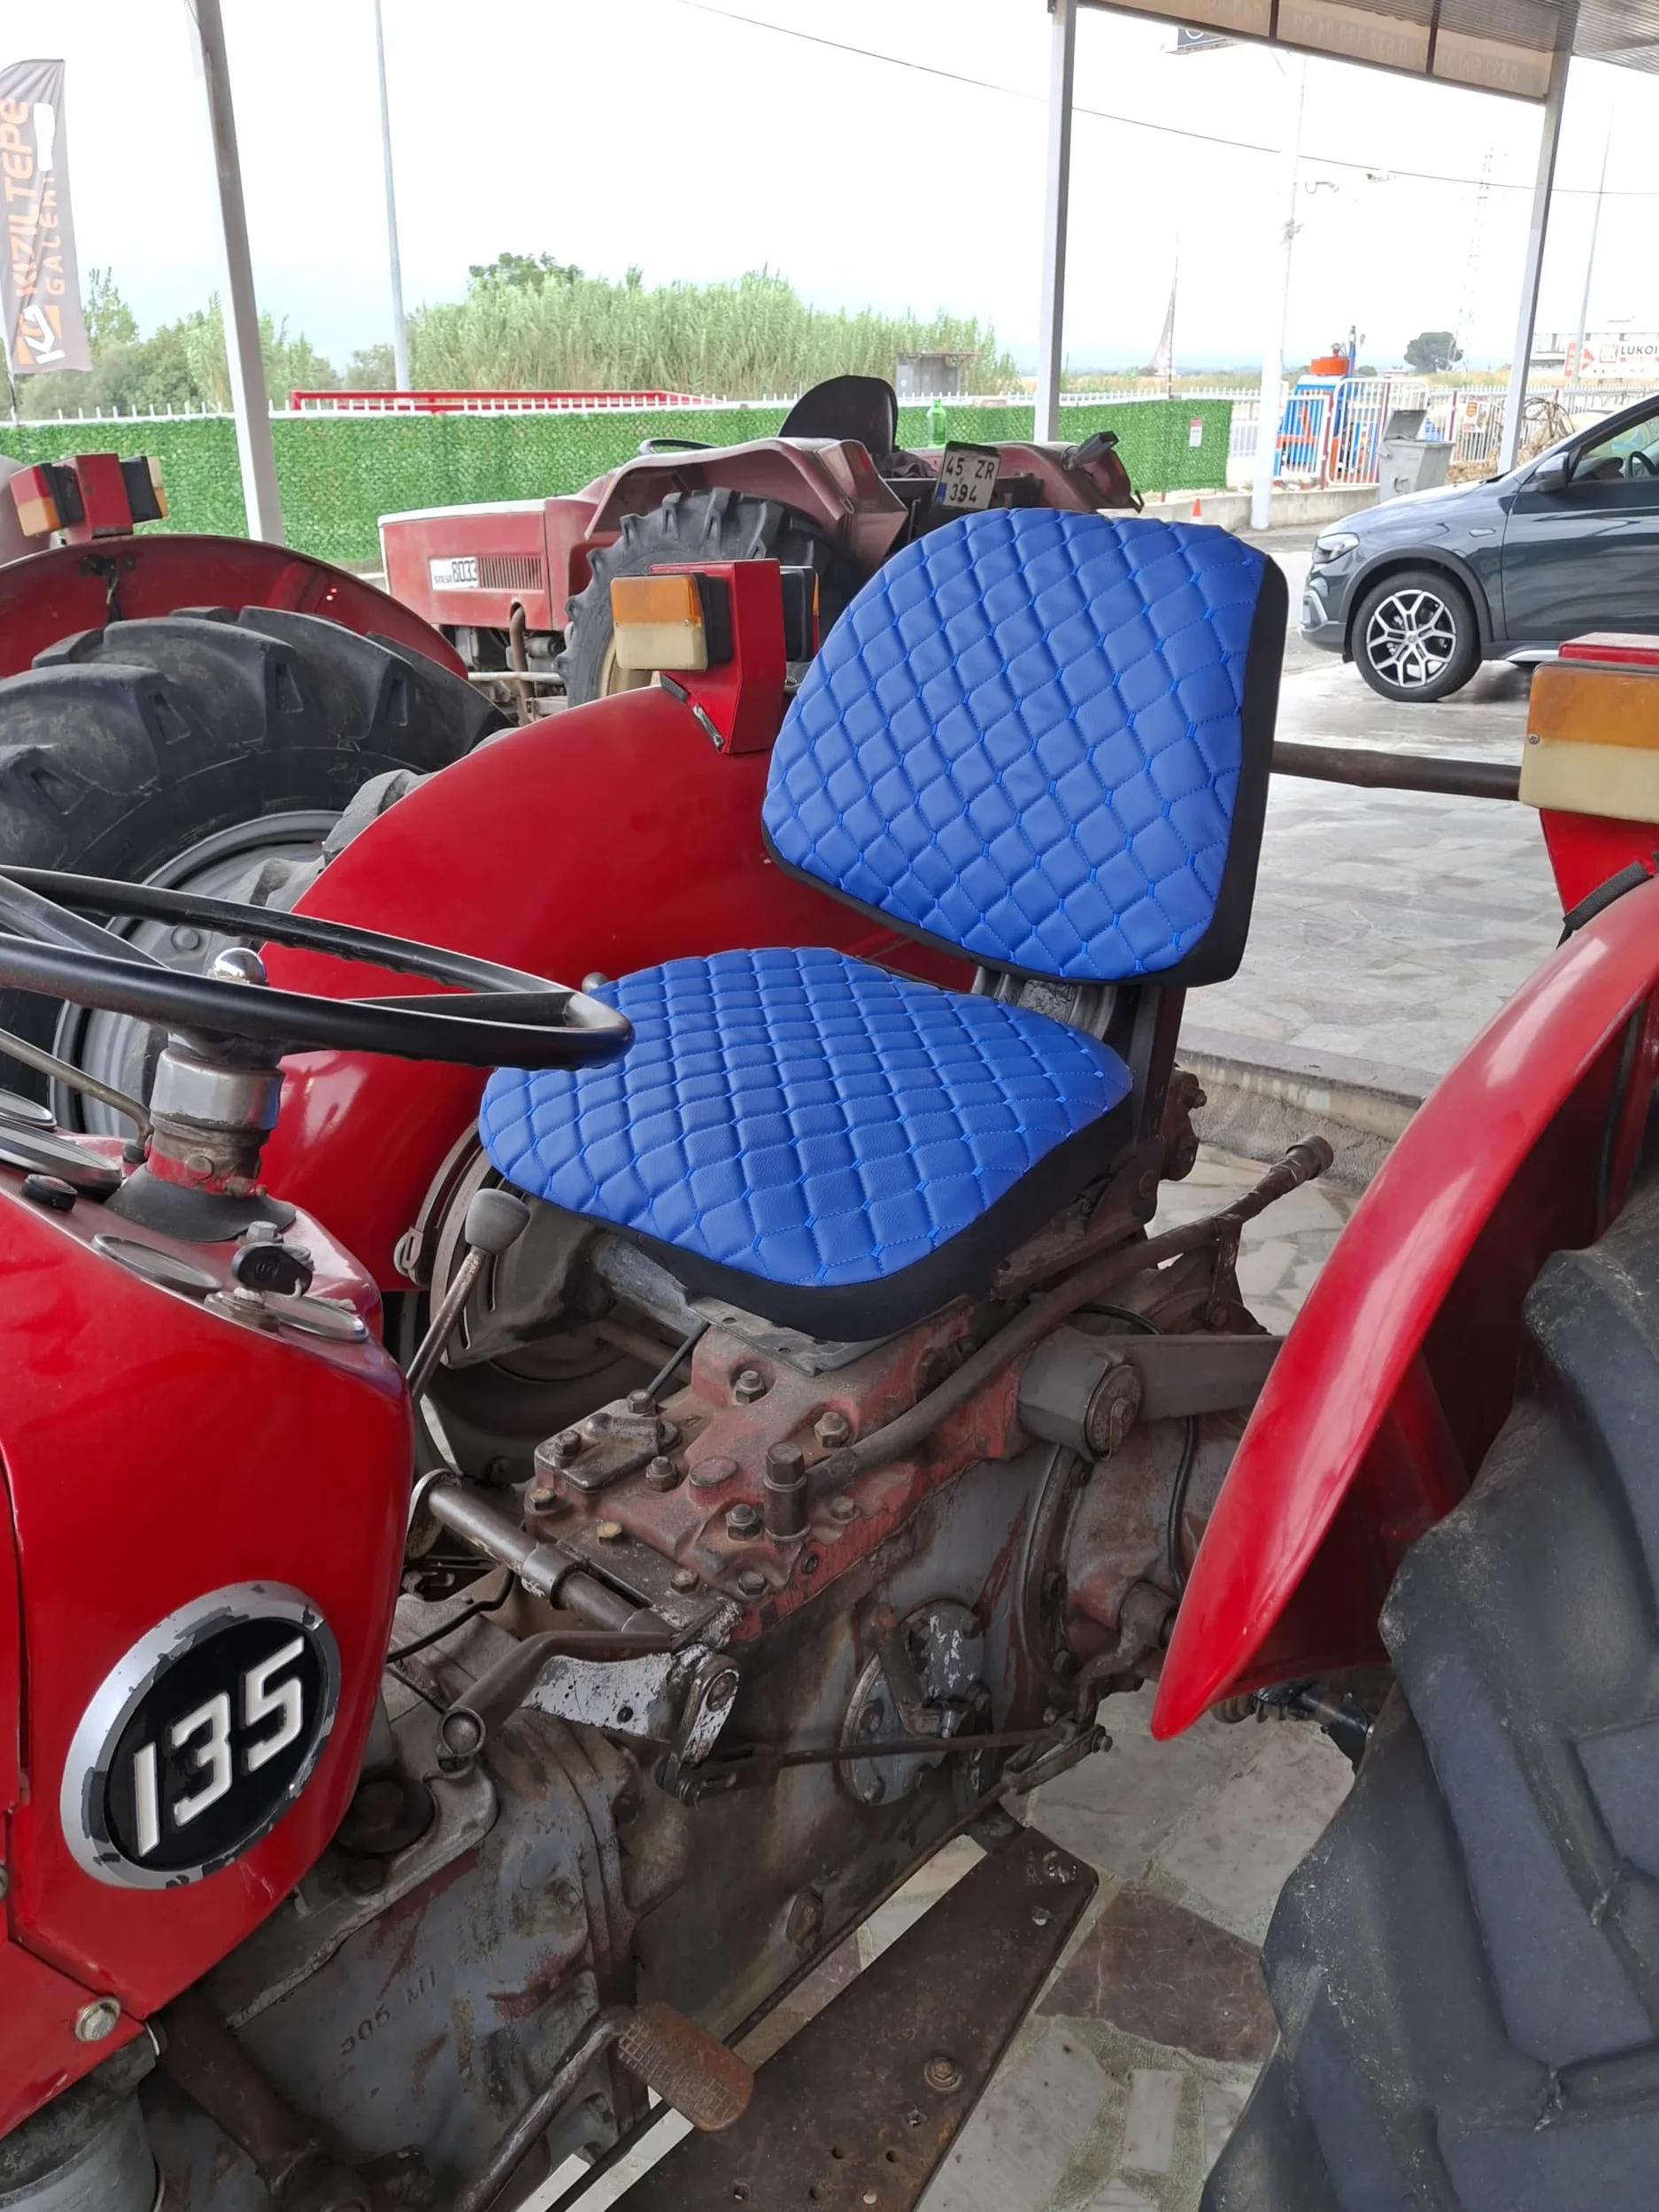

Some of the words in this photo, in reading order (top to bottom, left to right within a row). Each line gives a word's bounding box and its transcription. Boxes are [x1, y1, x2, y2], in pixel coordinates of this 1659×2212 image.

[945, 456, 966, 476] 45
[975, 459, 996, 480] ZR
[949, 483, 977, 503] 394
[135, 1636, 305, 1857] 135
